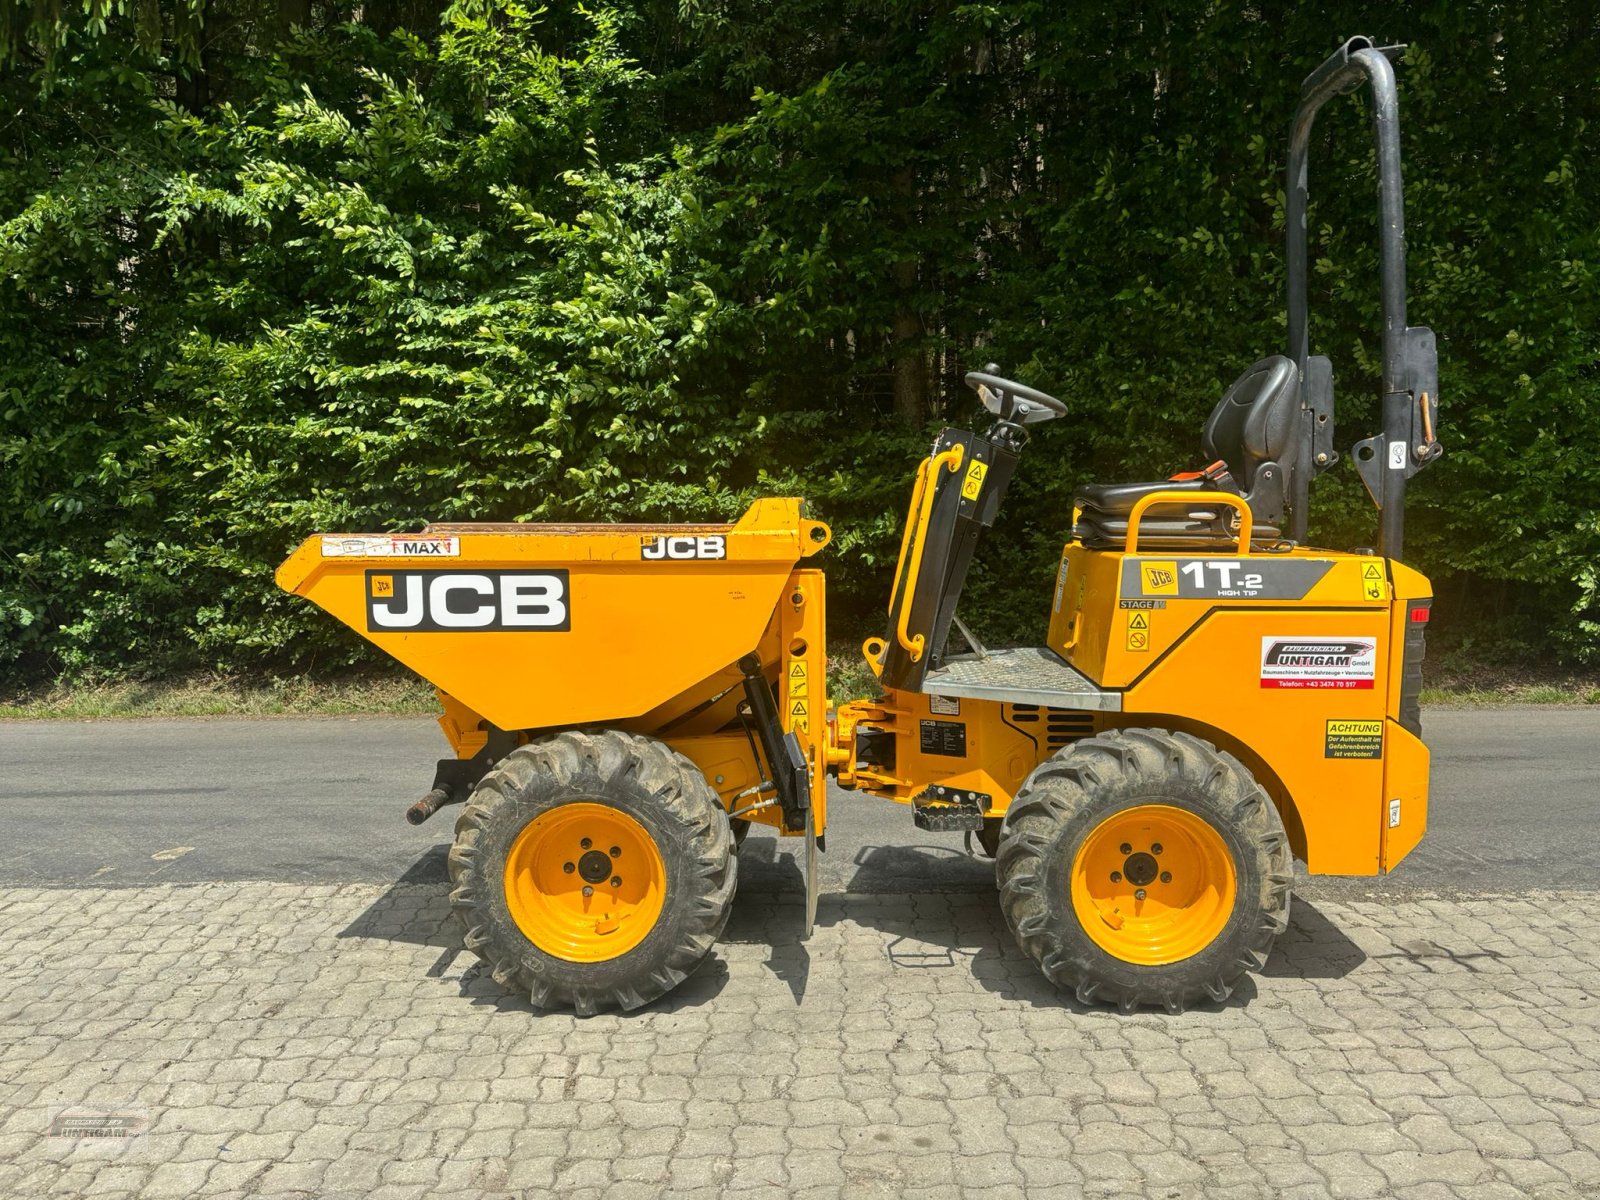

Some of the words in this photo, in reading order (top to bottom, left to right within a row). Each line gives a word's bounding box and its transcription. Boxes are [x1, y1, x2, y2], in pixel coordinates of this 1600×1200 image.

[403, 541, 442, 555] MAX
[642, 536, 725, 559] JCB
[1150, 569, 1173, 587] JCB
[372, 575, 566, 627] JCB
[1120, 600, 1152, 609] STAGE
[1330, 724, 1380, 733] ACHTUNG
